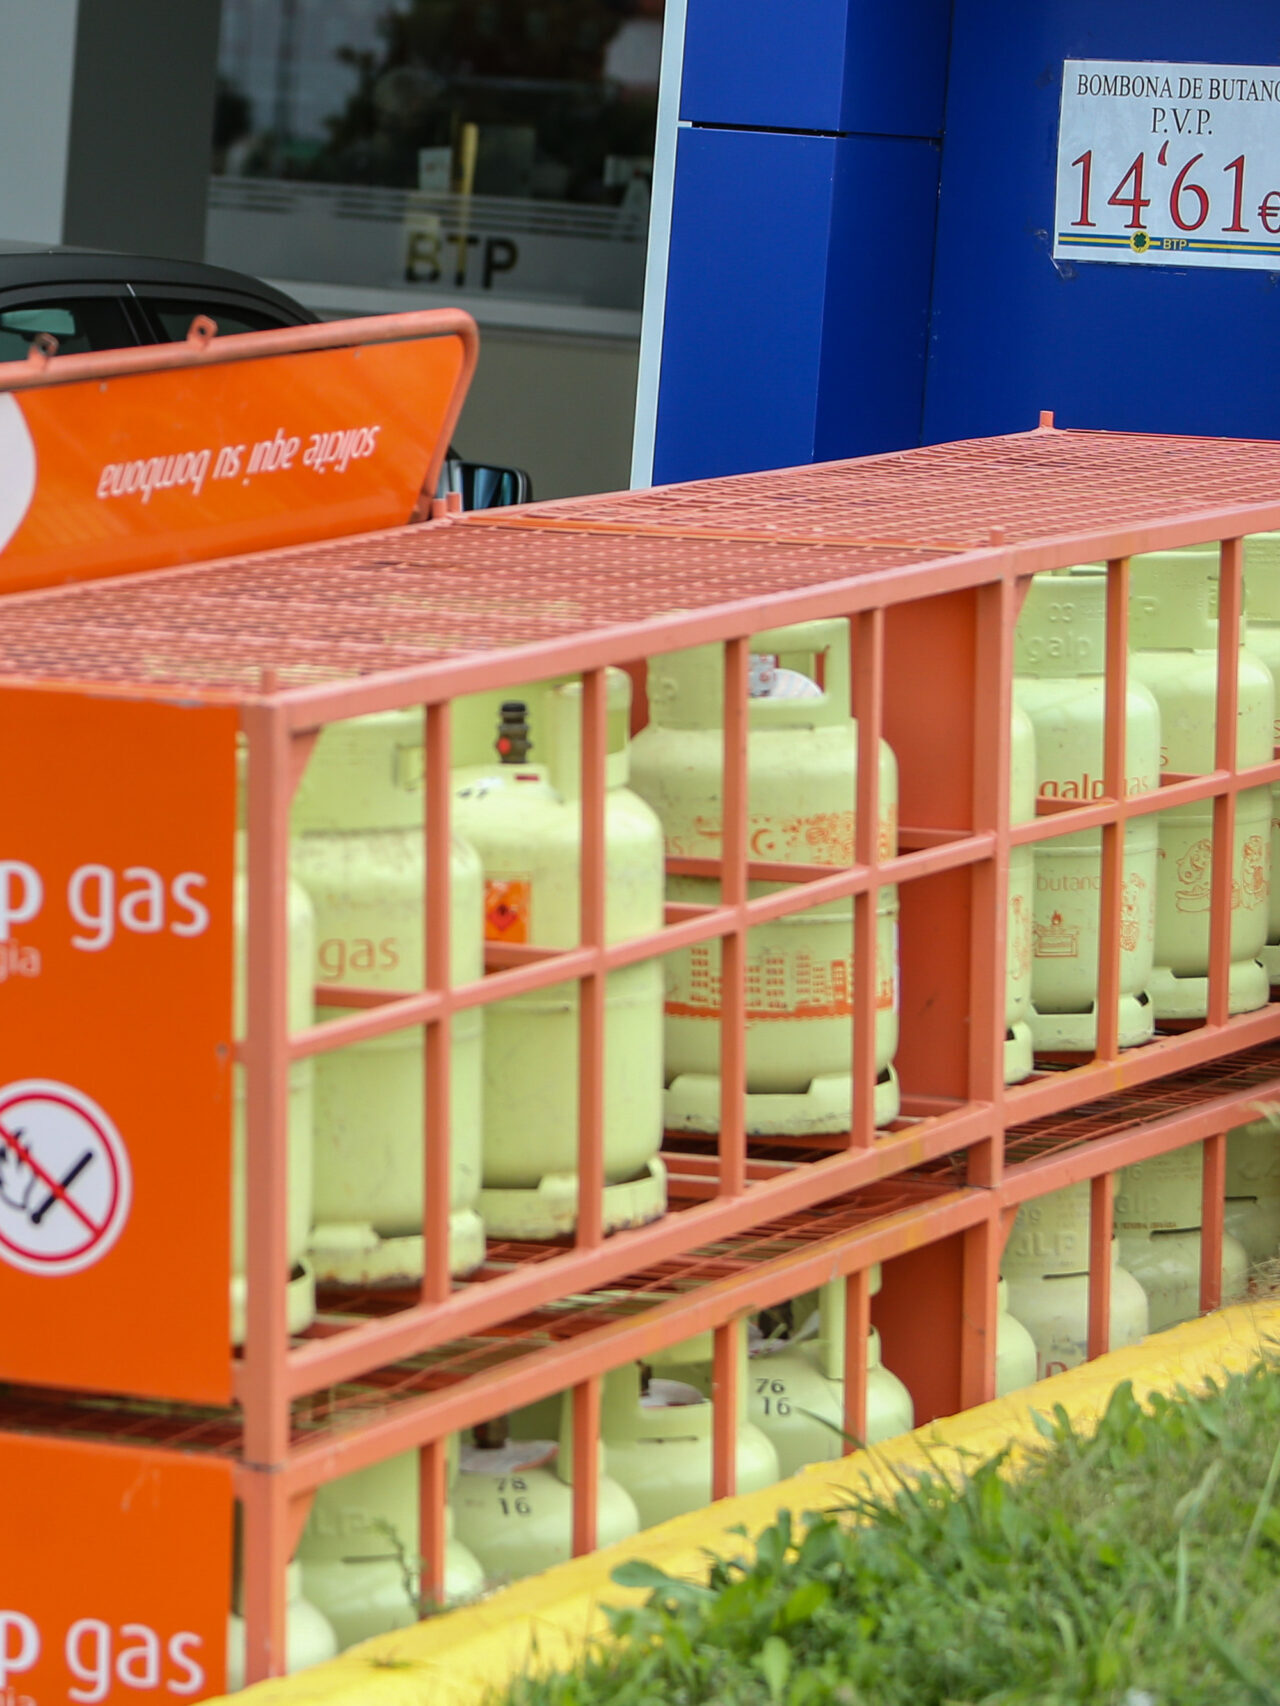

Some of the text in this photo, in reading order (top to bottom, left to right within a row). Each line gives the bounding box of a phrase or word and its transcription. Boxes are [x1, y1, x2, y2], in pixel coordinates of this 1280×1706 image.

[1077, 74, 1280, 103] BOMBONA DE BUTAN
[1151, 107, 1213, 135] P.V.P.
[405, 231, 518, 290] BTP
[1163, 238, 1188, 251] BTP
[212, 444, 246, 480] su
[303, 425, 380, 474] solicite
[96, 449, 212, 504] bombona
[67, 863, 210, 951] gas
[318, 937, 400, 984] gas
[755, 1377, 786, 1395] 76
[762, 1396, 791, 1416] 16
[498, 1496, 532, 1516] 16
[64, 1617, 206, 1704] gas
